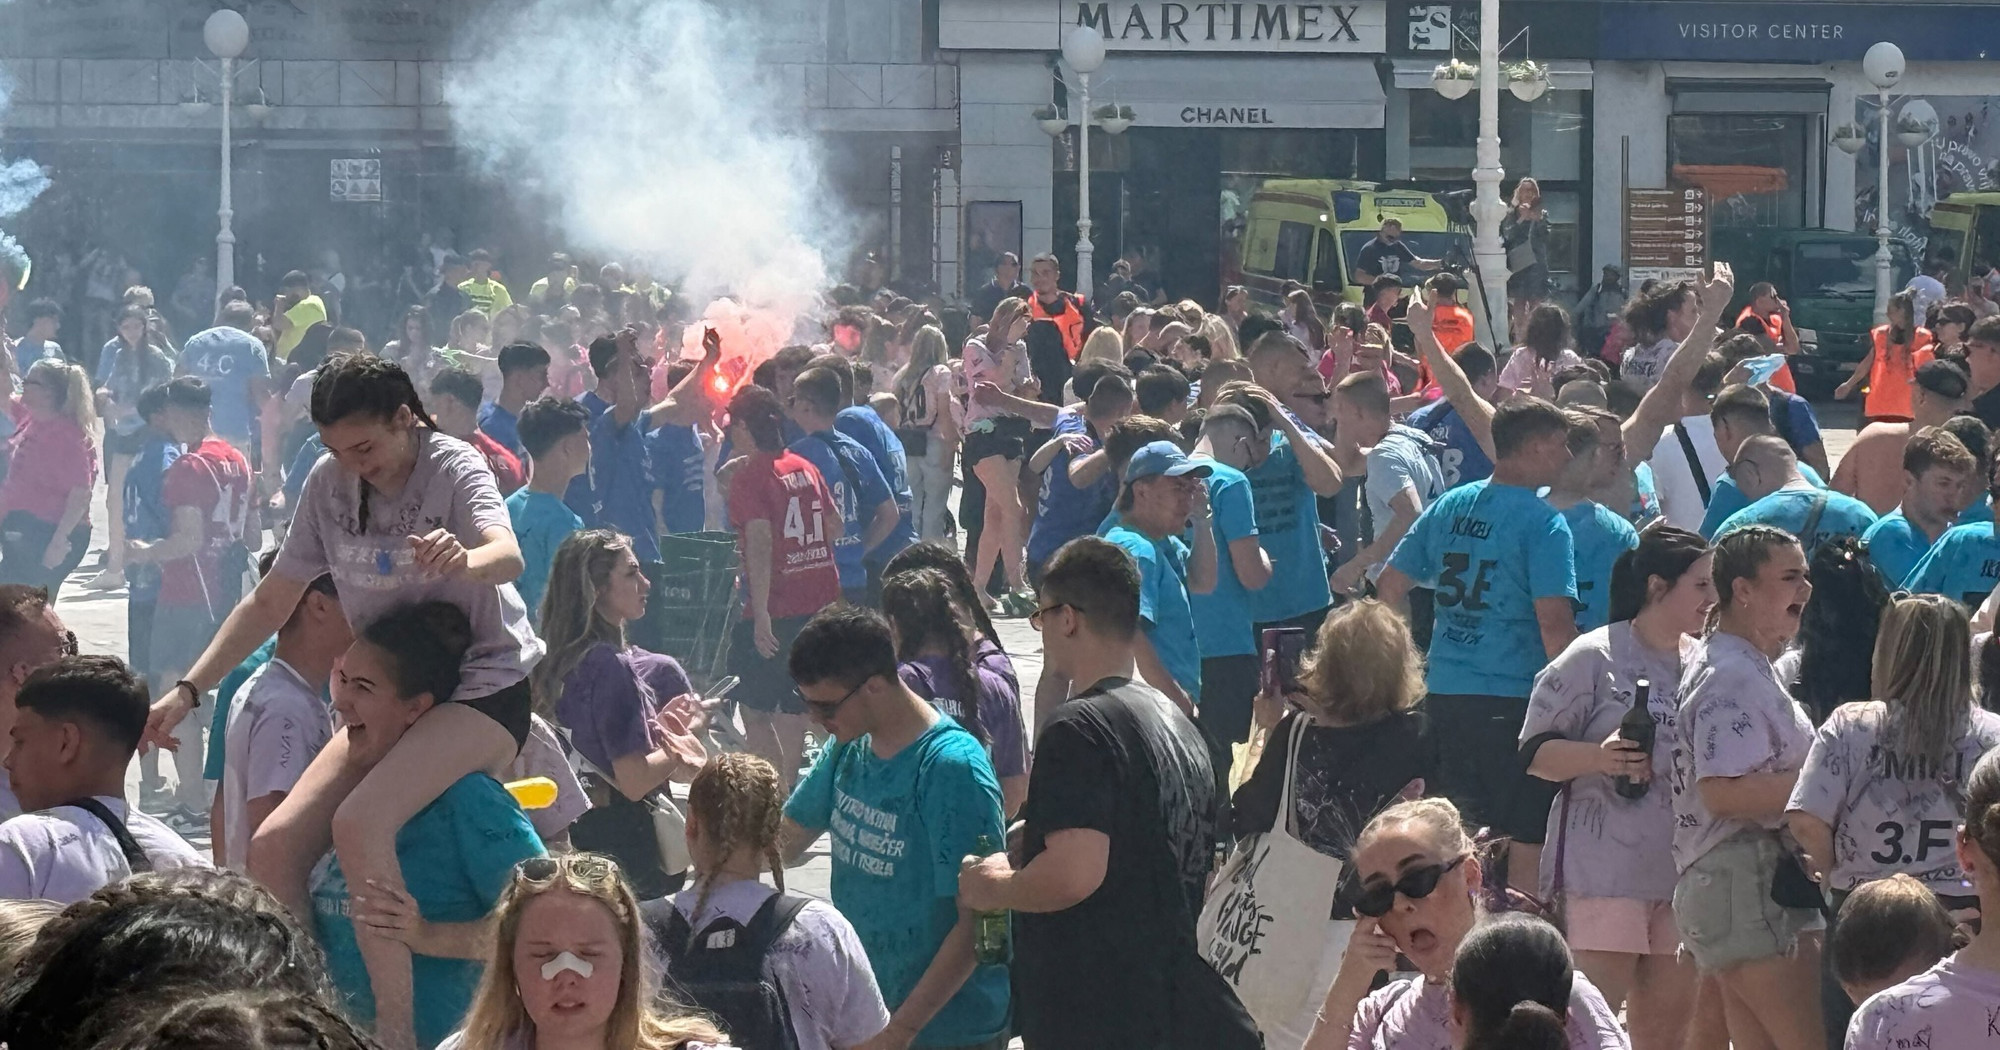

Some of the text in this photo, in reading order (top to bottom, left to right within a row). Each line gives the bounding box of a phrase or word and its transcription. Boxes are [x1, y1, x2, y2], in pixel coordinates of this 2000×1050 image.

[1077, 3, 1359, 43] MARTIMEX
[1679, 23, 1843, 39] VISITOR CENTER
[1180, 106, 1275, 124] CHANEL
[1871, 820, 1953, 864] 3.F
